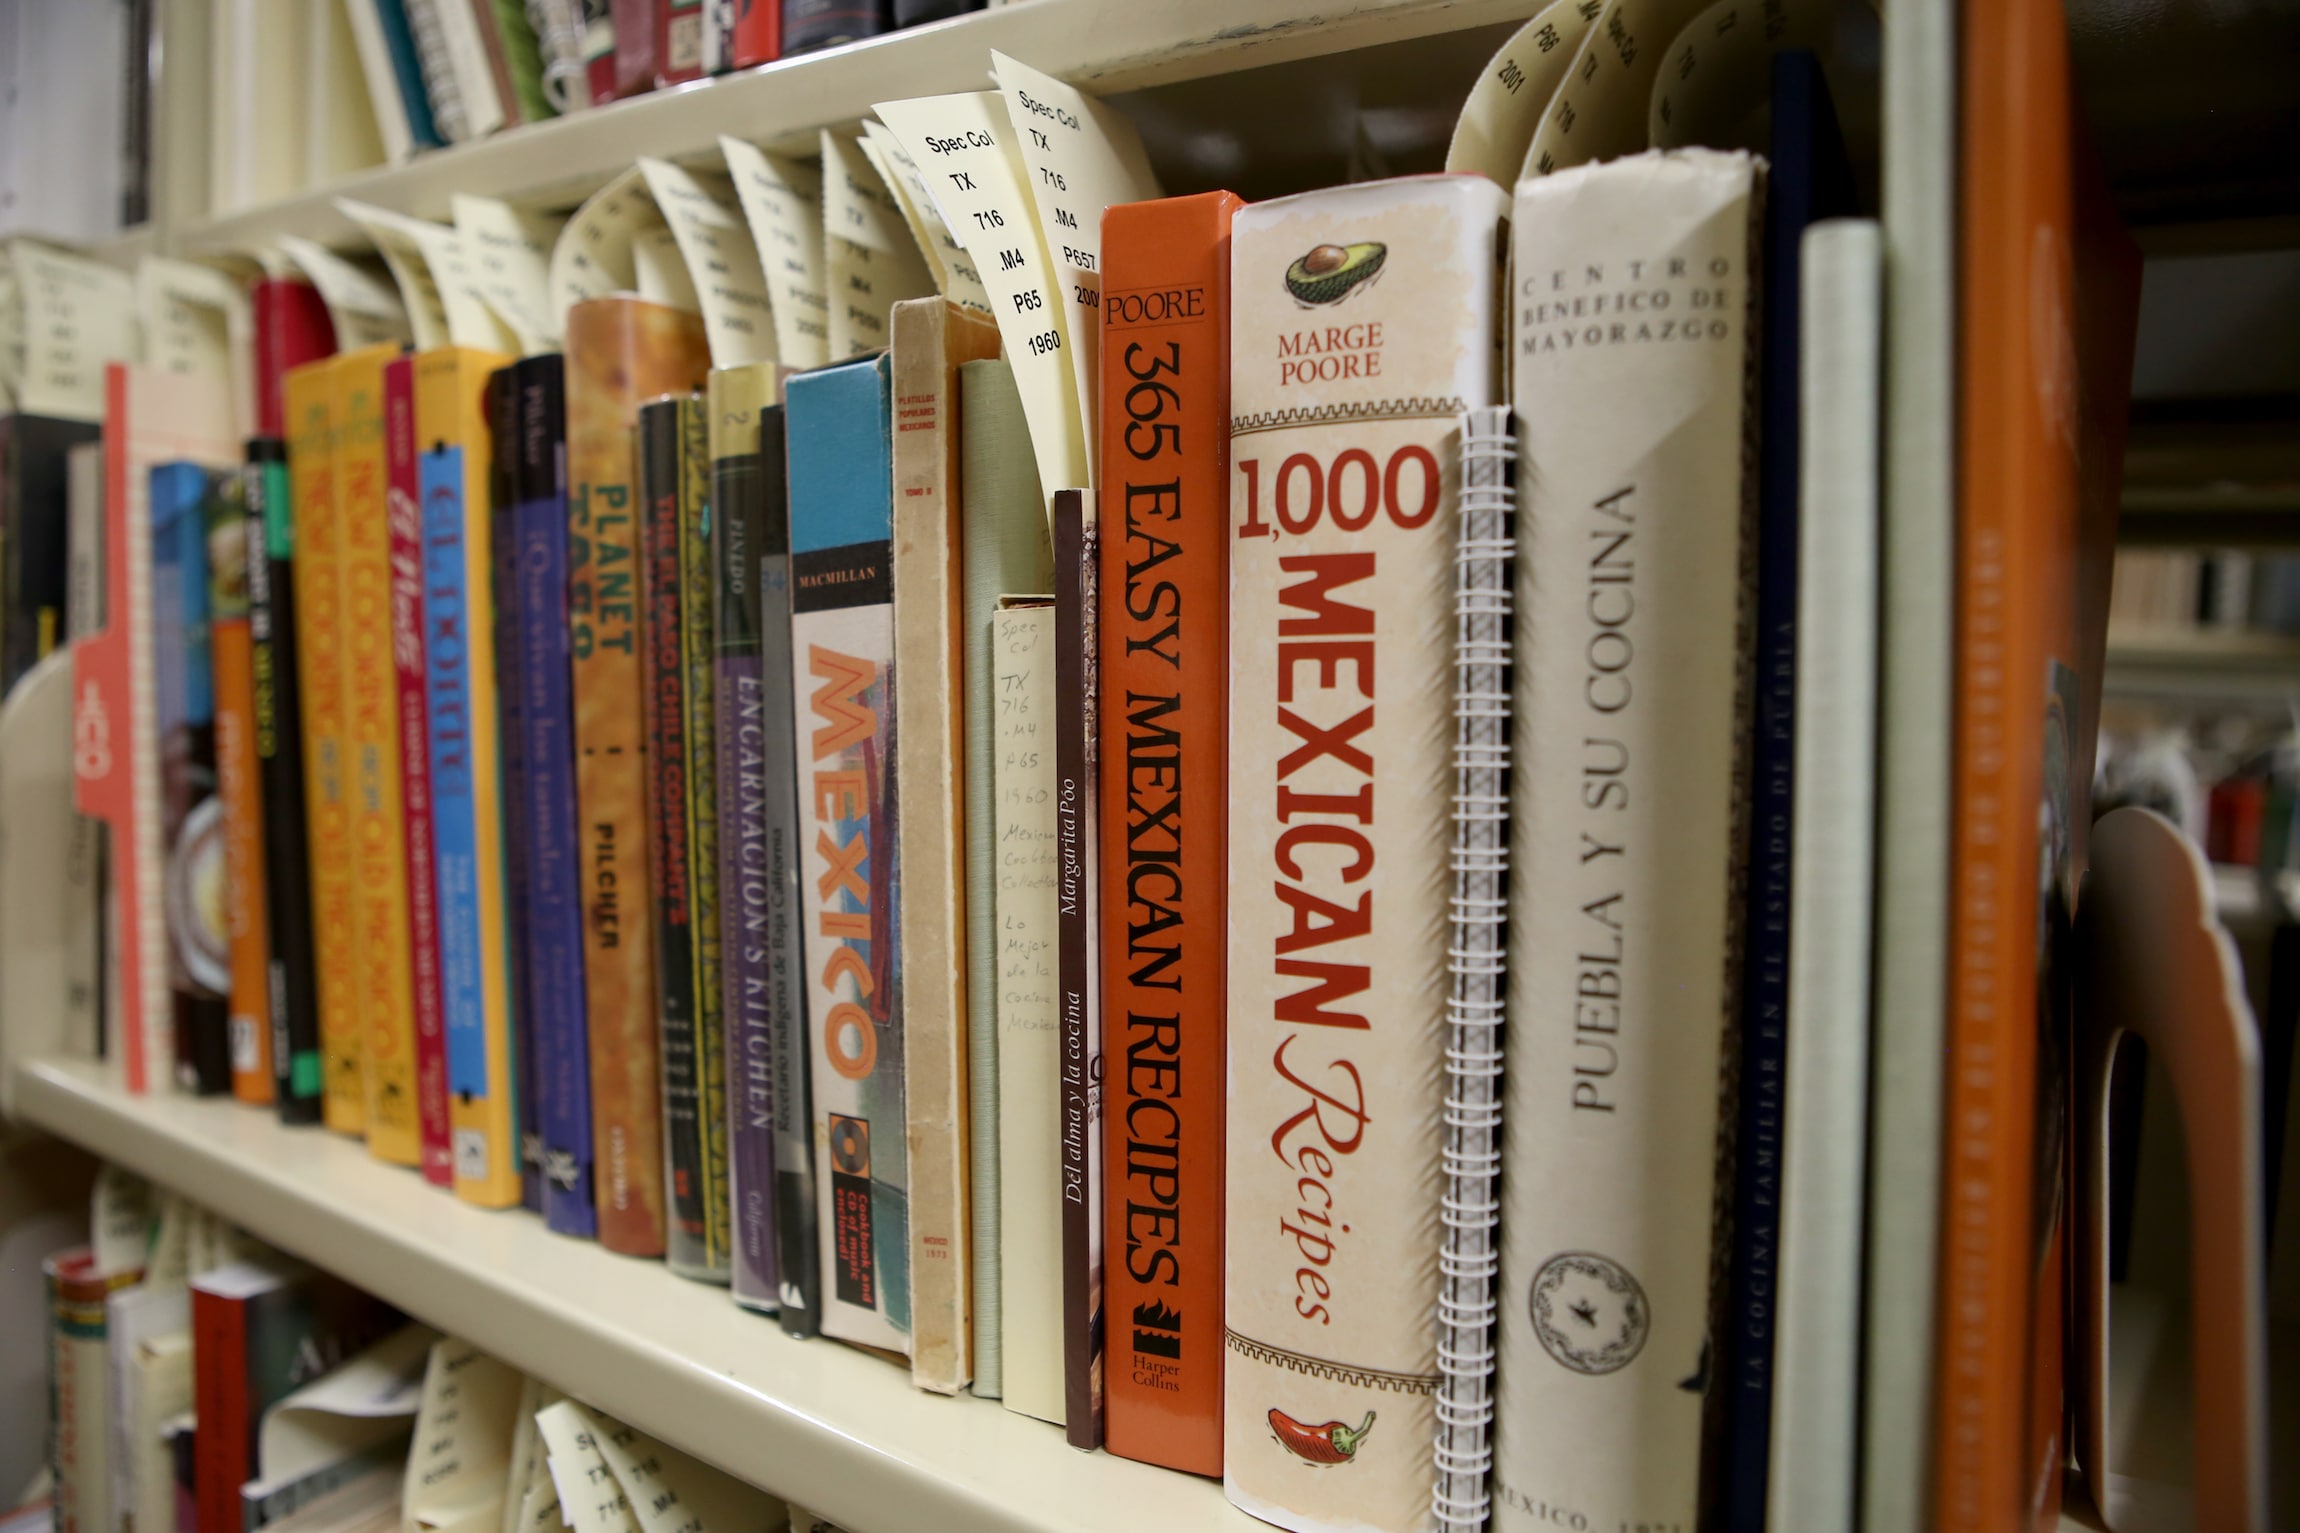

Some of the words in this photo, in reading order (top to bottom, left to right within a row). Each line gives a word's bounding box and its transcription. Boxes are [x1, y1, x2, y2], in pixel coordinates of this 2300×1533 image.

[1533, 22, 1560, 54] P66
[1497, 59, 1526, 95] 2001
[1018, 90, 1055, 120] Spec
[1058, 107, 1081, 131] Col
[925, 136, 967, 156] Spec
[966, 130, 995, 147] Col
[1029, 129, 1051, 151] TX
[949, 172, 977, 192] TX
[1040, 167, 1066, 191] 716
[973, 209, 1004, 230] 716
[1055, 207, 1078, 230] .M4
[1000, 248, 1025, 271] .M4
[1063, 245, 1096, 271] P657
[1013, 289, 1042, 314] P65
[1074, 285, 1099, 308] 200
[1105, 288, 1205, 325] POORE
[1523, 292, 1671, 328] BENEFICO
[1690, 289, 1730, 311] DE
[1028, 329, 1061, 356] 1960
[1277, 322, 1384, 359] MARGE
[1523, 319, 1729, 356] MAYORAZGO
[1280, 352, 1382, 386] POORE
[1123, 341, 1181, 462] 365
[1237, 445, 1440, 542] 1,000
[595, 484, 634, 657] PLANET
[729, 518, 747, 595] PINEDO
[1122, 476, 1183, 670] EASY
[799, 566, 877, 589] MACMILLAN
[1586, 483, 1637, 715] COCINA
[1000, 670, 1030, 692] TX
[1001, 695, 1029, 715] 716
[1273, 551, 1375, 1030] MEXICAN
[1582, 737, 1629, 812] SU
[1060, 778, 1076, 816] Póo
[1123, 692, 1183, 993] MEXICAN
[1580, 832, 1626, 866] Y
[809, 643, 878, 1081] MEXICO
[1060, 818, 1082, 916] Margarita
[594, 823, 620, 950] PILCHER
[1572, 891, 1624, 1115] PUEBLA
[1065, 991, 1081, 1060] cocina
[745, 976, 774, 1131] KITCHEN
[1065, 1065, 1082, 1086] la
[1069, 1090, 1088, 1104] y
[1067, 1107, 1082, 1162] alma
[1123, 1011, 1183, 1285] RECIPES
[1271, 1034, 1372, 1327] Recipes
[858, 1193, 872, 1268] Cookbook
[1132, 1355, 1182, 1378] Harper
[1132, 1372, 1182, 1392] Collins
